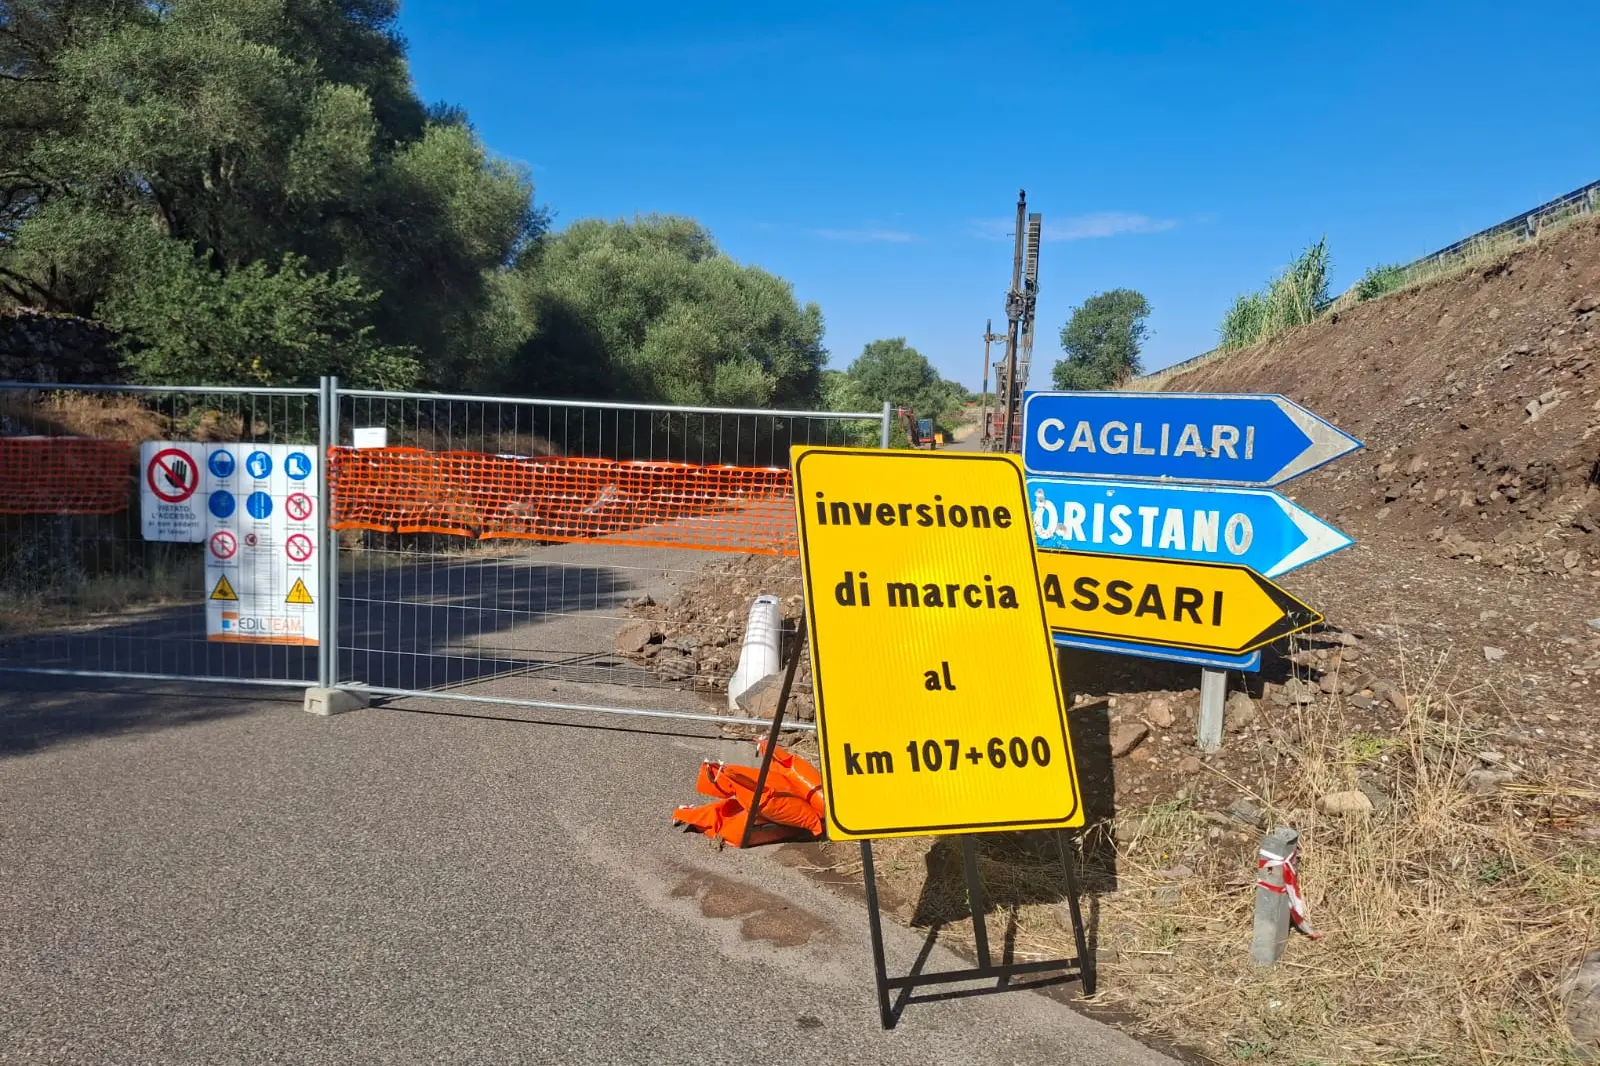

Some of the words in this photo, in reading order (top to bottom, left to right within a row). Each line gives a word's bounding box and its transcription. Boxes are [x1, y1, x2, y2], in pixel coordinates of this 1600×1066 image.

[1036, 418, 1255, 460] CAGLIARI
[815, 491, 1012, 529] inversione
[1034, 499, 1253, 555] ORISTANO
[835, 571, 870, 607] di
[886, 574, 1019, 609] marcia
[1043, 573, 1223, 627] ASSARI
[924, 661, 956, 691] al
[843, 743, 894, 776] km
[906, 736, 1051, 772] 107+600
